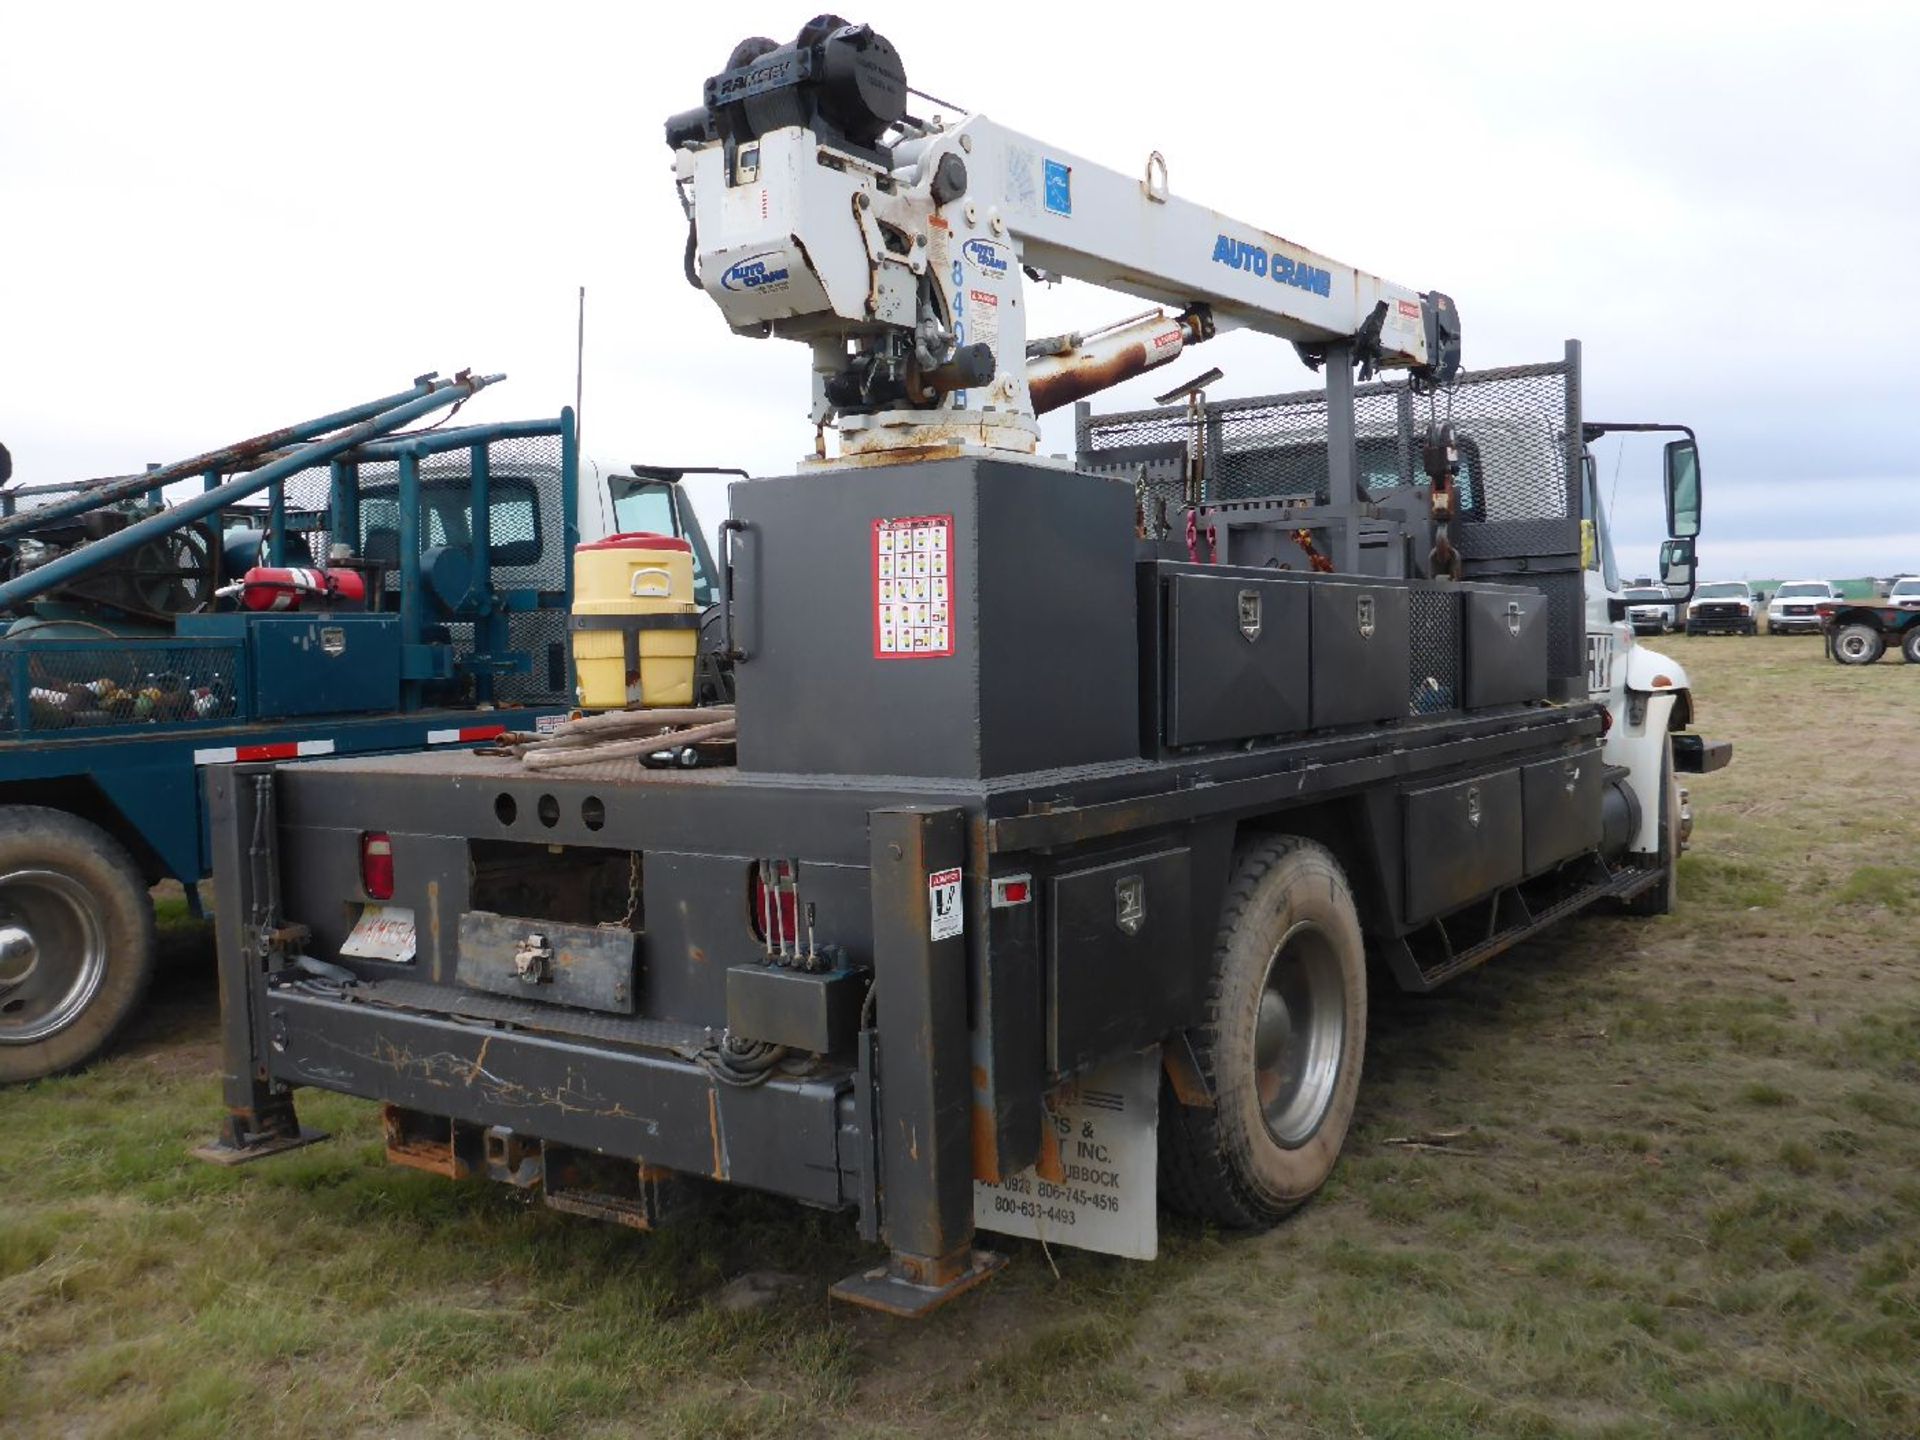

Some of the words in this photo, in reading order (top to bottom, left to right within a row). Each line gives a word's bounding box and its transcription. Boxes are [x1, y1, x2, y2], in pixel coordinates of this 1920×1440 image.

[971, 242, 994, 257] AUTO
[731, 261, 765, 280] AUTO
[978, 253, 1007, 270] CRANE
[1212, 234, 1267, 277] AUTO
[1271, 253, 1331, 298] CRANE
[743, 268, 789, 287] CRANE
[1081, 1120, 1094, 1139] &
[1077, 1140, 1112, 1164] INC.
[1062, 1164, 1120, 1188] UBBOCK
[1037, 1181, 1119, 1212] 806-745-4516
[994, 1195, 1076, 1225] 800-633-4493
